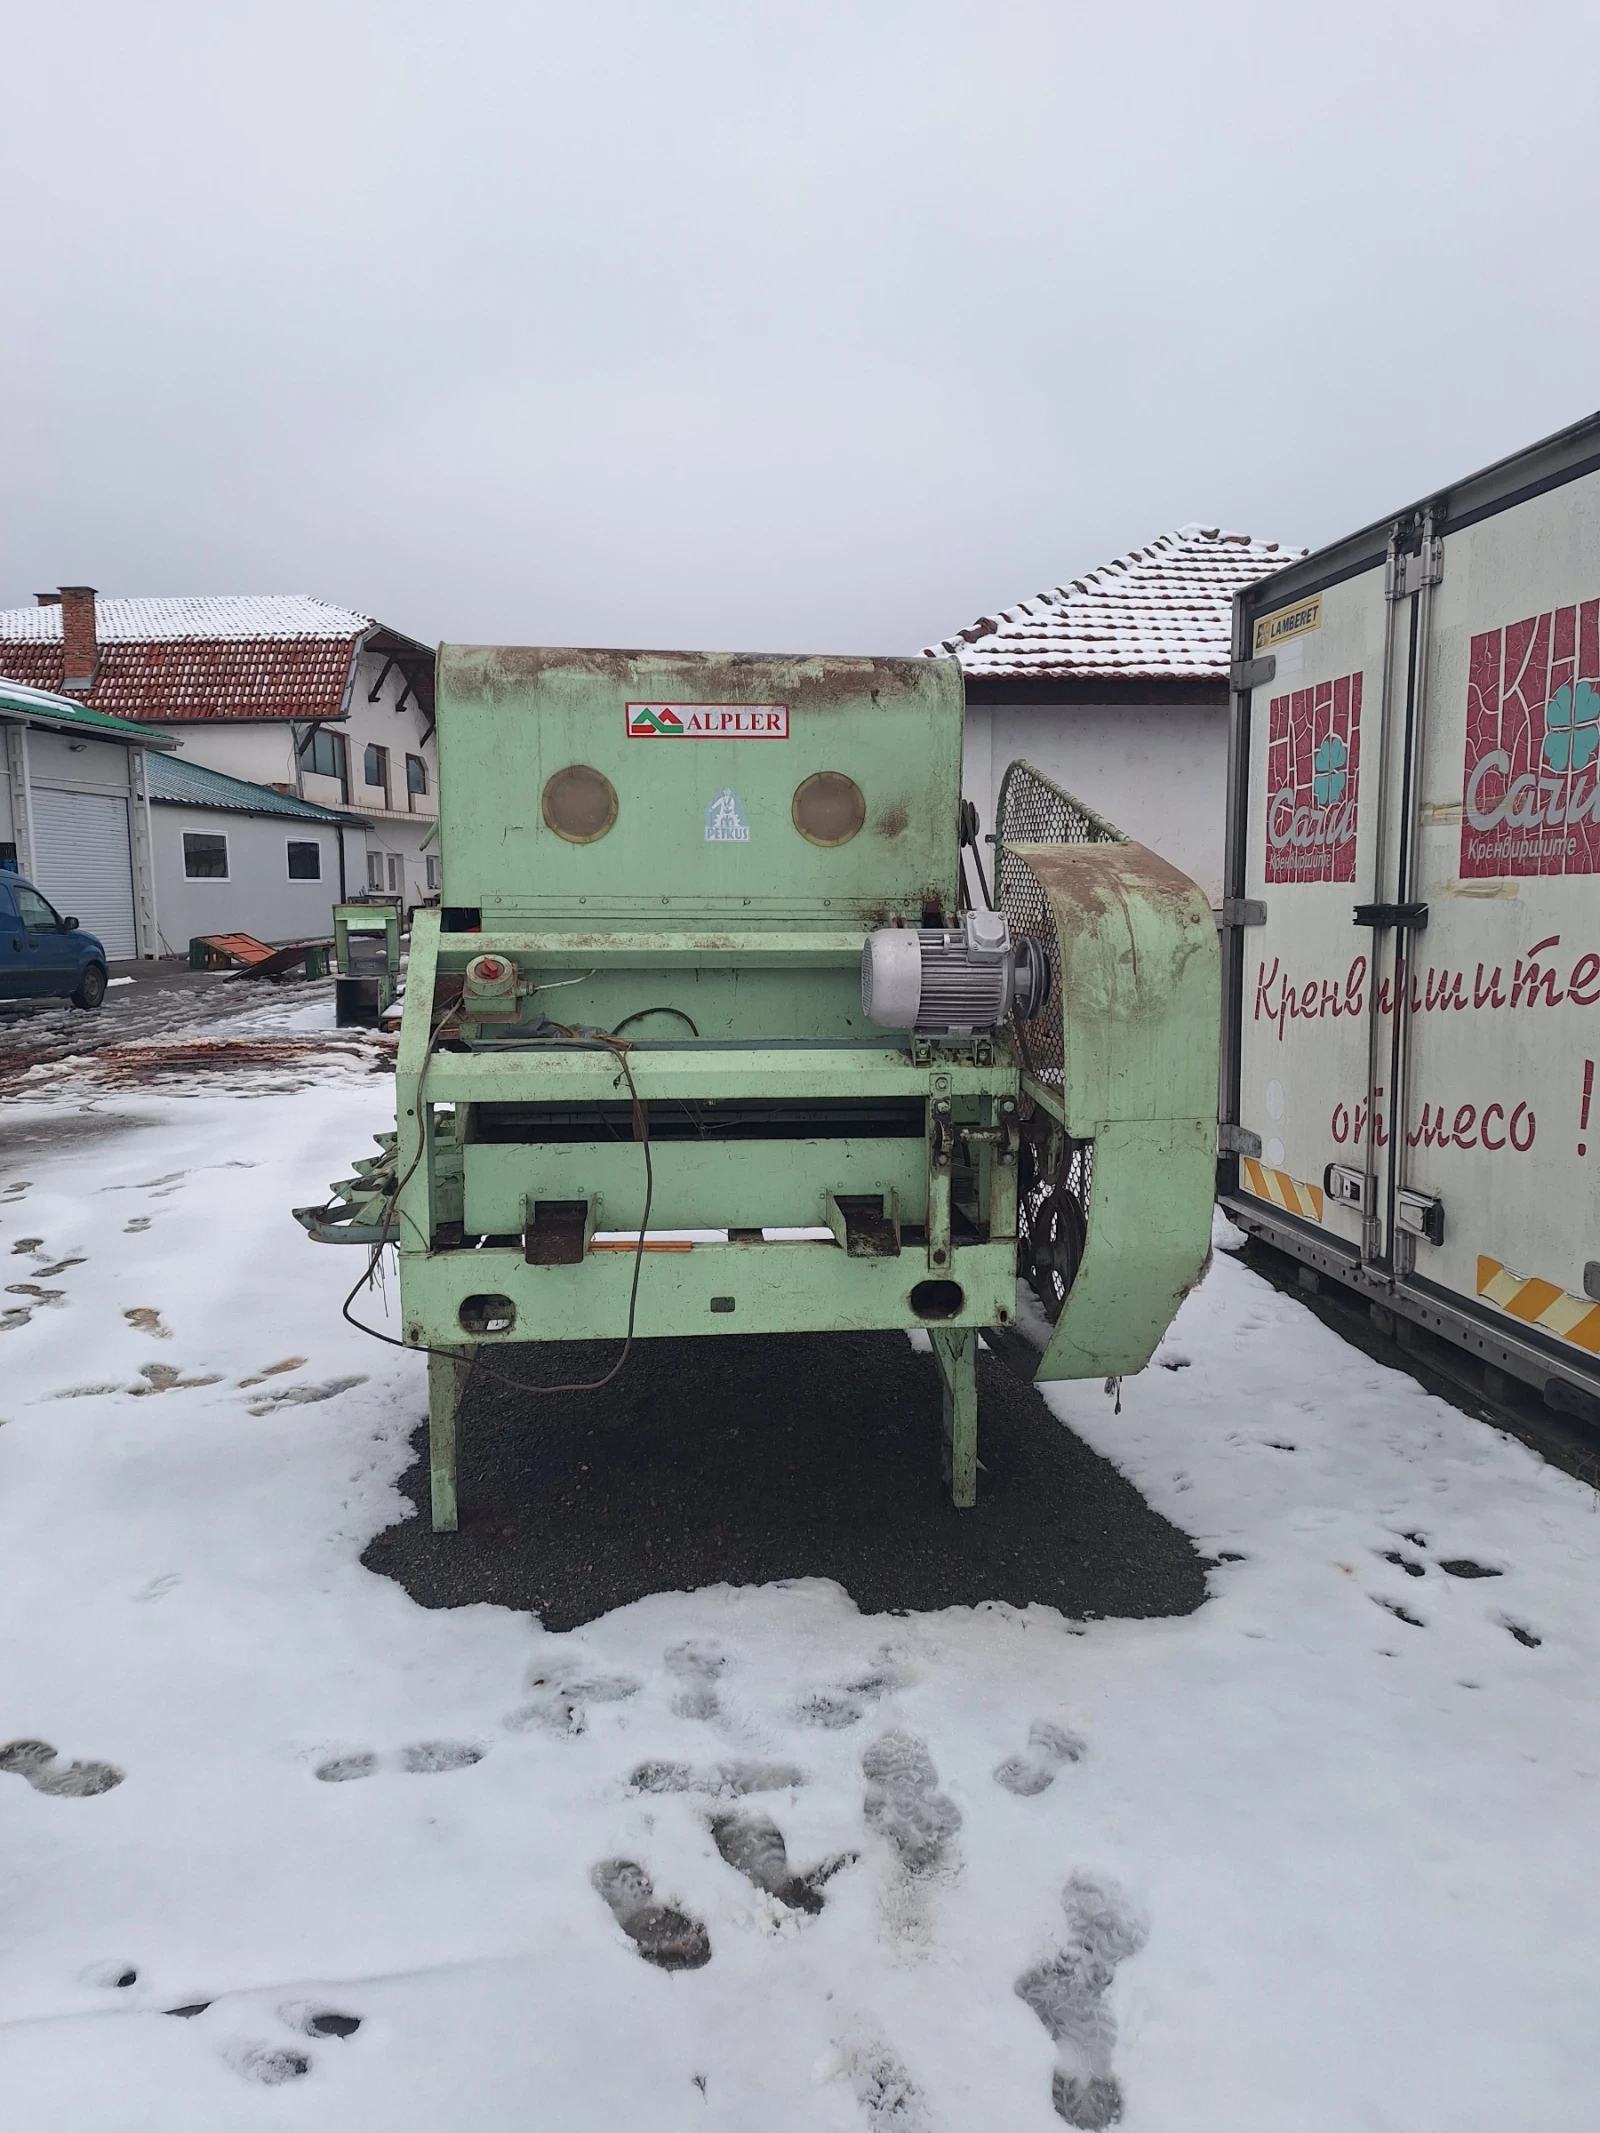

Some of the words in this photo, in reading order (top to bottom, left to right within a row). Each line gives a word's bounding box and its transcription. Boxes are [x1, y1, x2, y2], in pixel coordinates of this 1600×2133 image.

[1270, 605, 1320, 638] LAMBERET
[687, 713, 781, 731] ALPLER
[706, 828, 748, 840] PETKUS
[1467, 837, 1577, 865] Кренвиршите
[1406, 1101, 1536, 1152] месо
